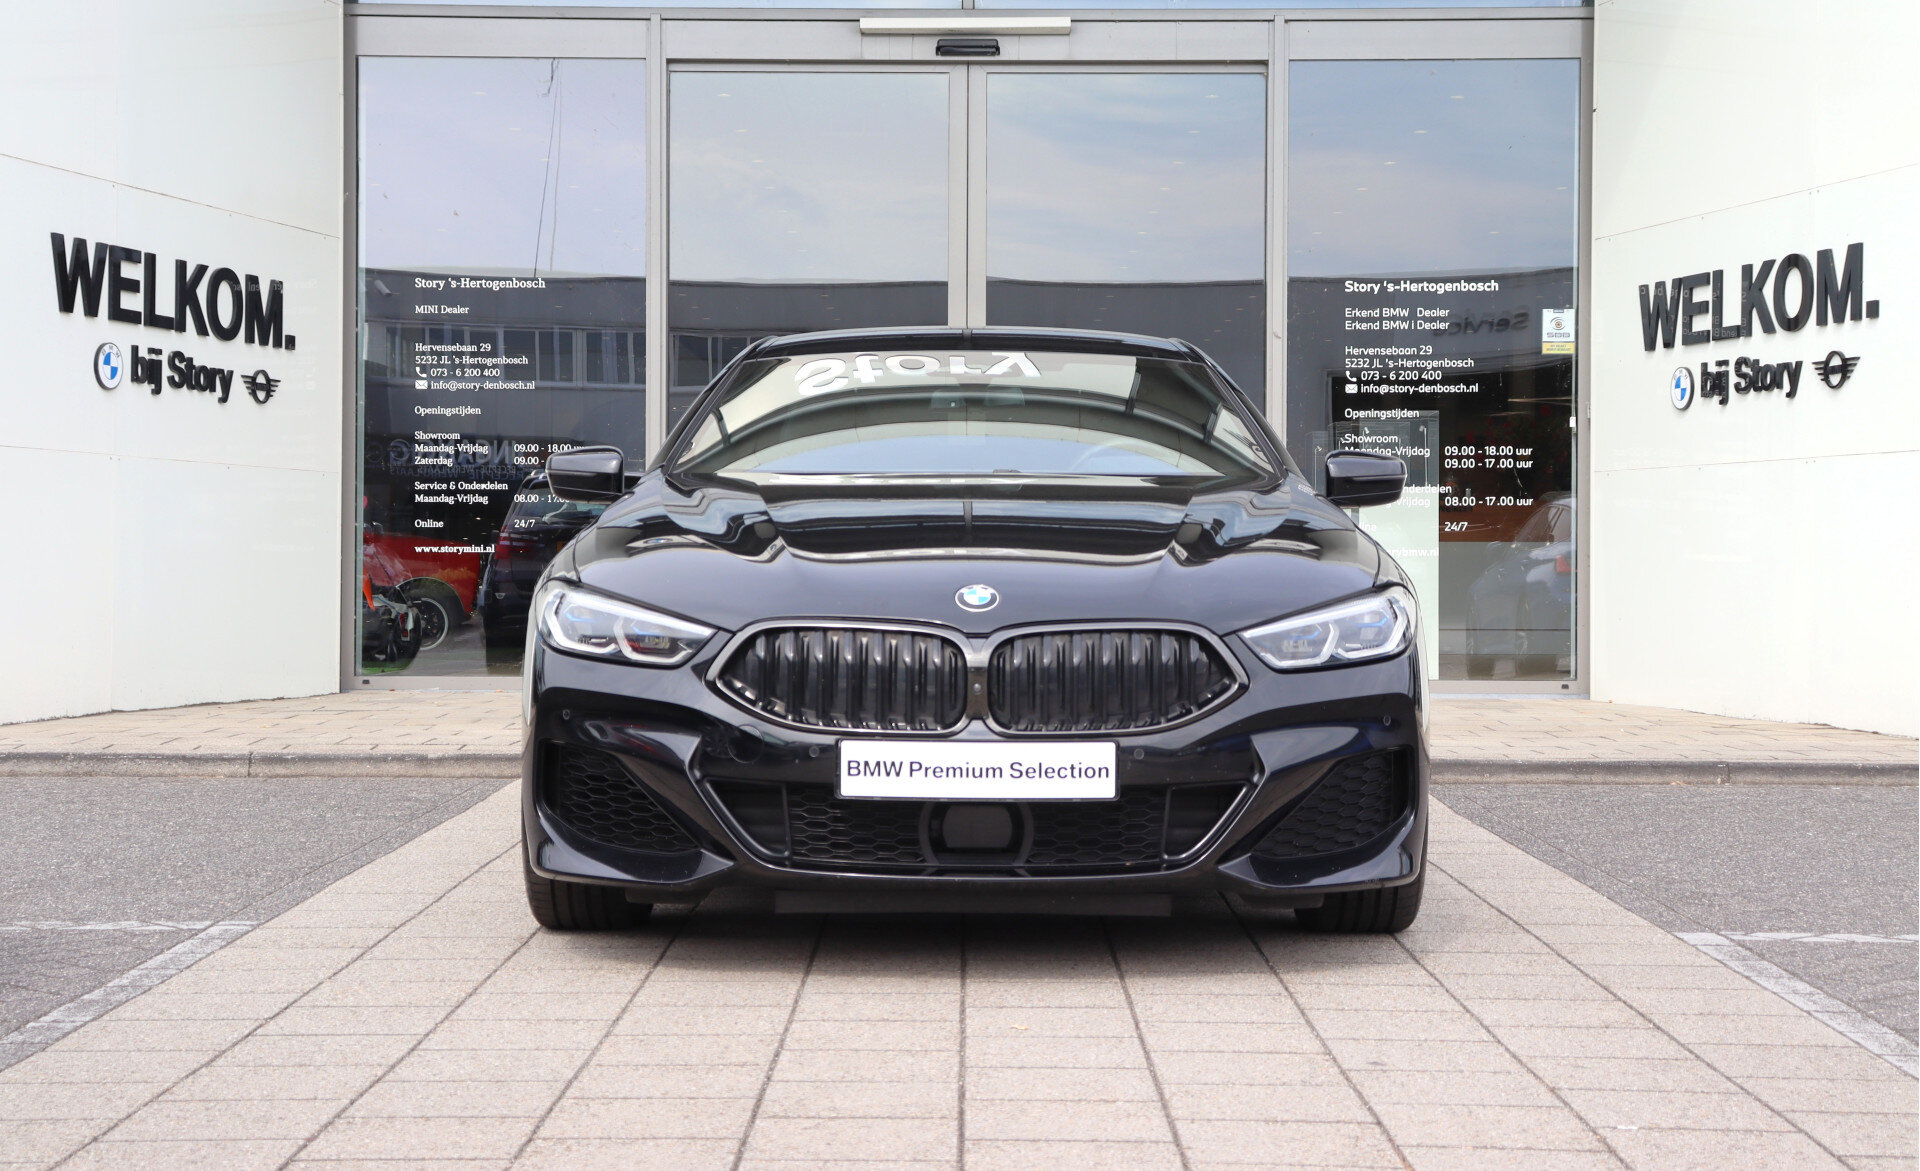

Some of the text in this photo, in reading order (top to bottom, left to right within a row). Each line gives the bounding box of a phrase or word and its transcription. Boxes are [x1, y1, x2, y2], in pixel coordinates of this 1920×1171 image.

[414, 277, 446, 291] Story
[1344, 280, 1381, 295] Story
[50, 232, 296, 351] WELKOM.
[1638, 242, 1880, 352] WELKOM.
[415, 304, 470, 314] MINI Dealer
[1345, 307, 1450, 318] Erkend BMW Dealer
[1345, 320, 1450, 330] Erkend BMW i Dealer
[415, 342, 491, 352] Hervensebaan 29
[1345, 345, 1433, 356] Hervensebaan 29
[415, 355, 438, 364] 5232
[439, 355, 451, 364] JL
[1345, 358, 1370, 368] 5232
[1371, 358, 1384, 369] JL
[130, 344, 235, 404] bij Story
[430, 368, 448, 377] 073
[455, 368, 462, 377] 6
[464, 368, 481, 377] 200
[482, 368, 500, 377] 400
[1361, 370, 1380, 381] 073
[1389, 370, 1396, 381] 6
[1398, 370, 1419, 380] 200
[1421, 370, 1442, 380] 400
[430, 380, 535, 392] info@story-denbosch.nl
[1700, 356, 1804, 406] bij Story
[1360, 382, 1479, 395] info@story-denbosch.nl
[414, 405, 482, 417] Openingstijden
[1344, 408, 1420, 420] Openingstijden
[414, 430, 461, 440] Showroom
[1344, 433, 1399, 443] Showroom
[414, 443, 489, 455] Maandag-Vrijdag
[513, 443, 539, 453] 09.00
[547, 443, 572, 453] 18.00
[1444, 446, 1475, 456] 09.00
[1484, 445, 1514, 456] 18.00
[1515, 448, 1533, 456] uur
[414, 455, 453, 467] Zaterdag
[513, 456, 539, 465] 09.00
[1444, 458, 1475, 469] 09.00
[1516, 460, 1534, 468] uur
[414, 481, 448, 490] Service
[449, 481, 456, 490] &
[414, 493, 489, 505] Maandag-Vrijdag
[513, 494, 539, 503] 08.00
[1444, 496, 1476, 506] 08.00
[1516, 498, 1534, 506] uur
[414, 519, 536, 528] Online 24/7
[1444, 521, 1468, 532] 24/7
[414, 543, 495, 555] www.storymini.nl
[847, 760, 1110, 779] BMW Premium Selection
